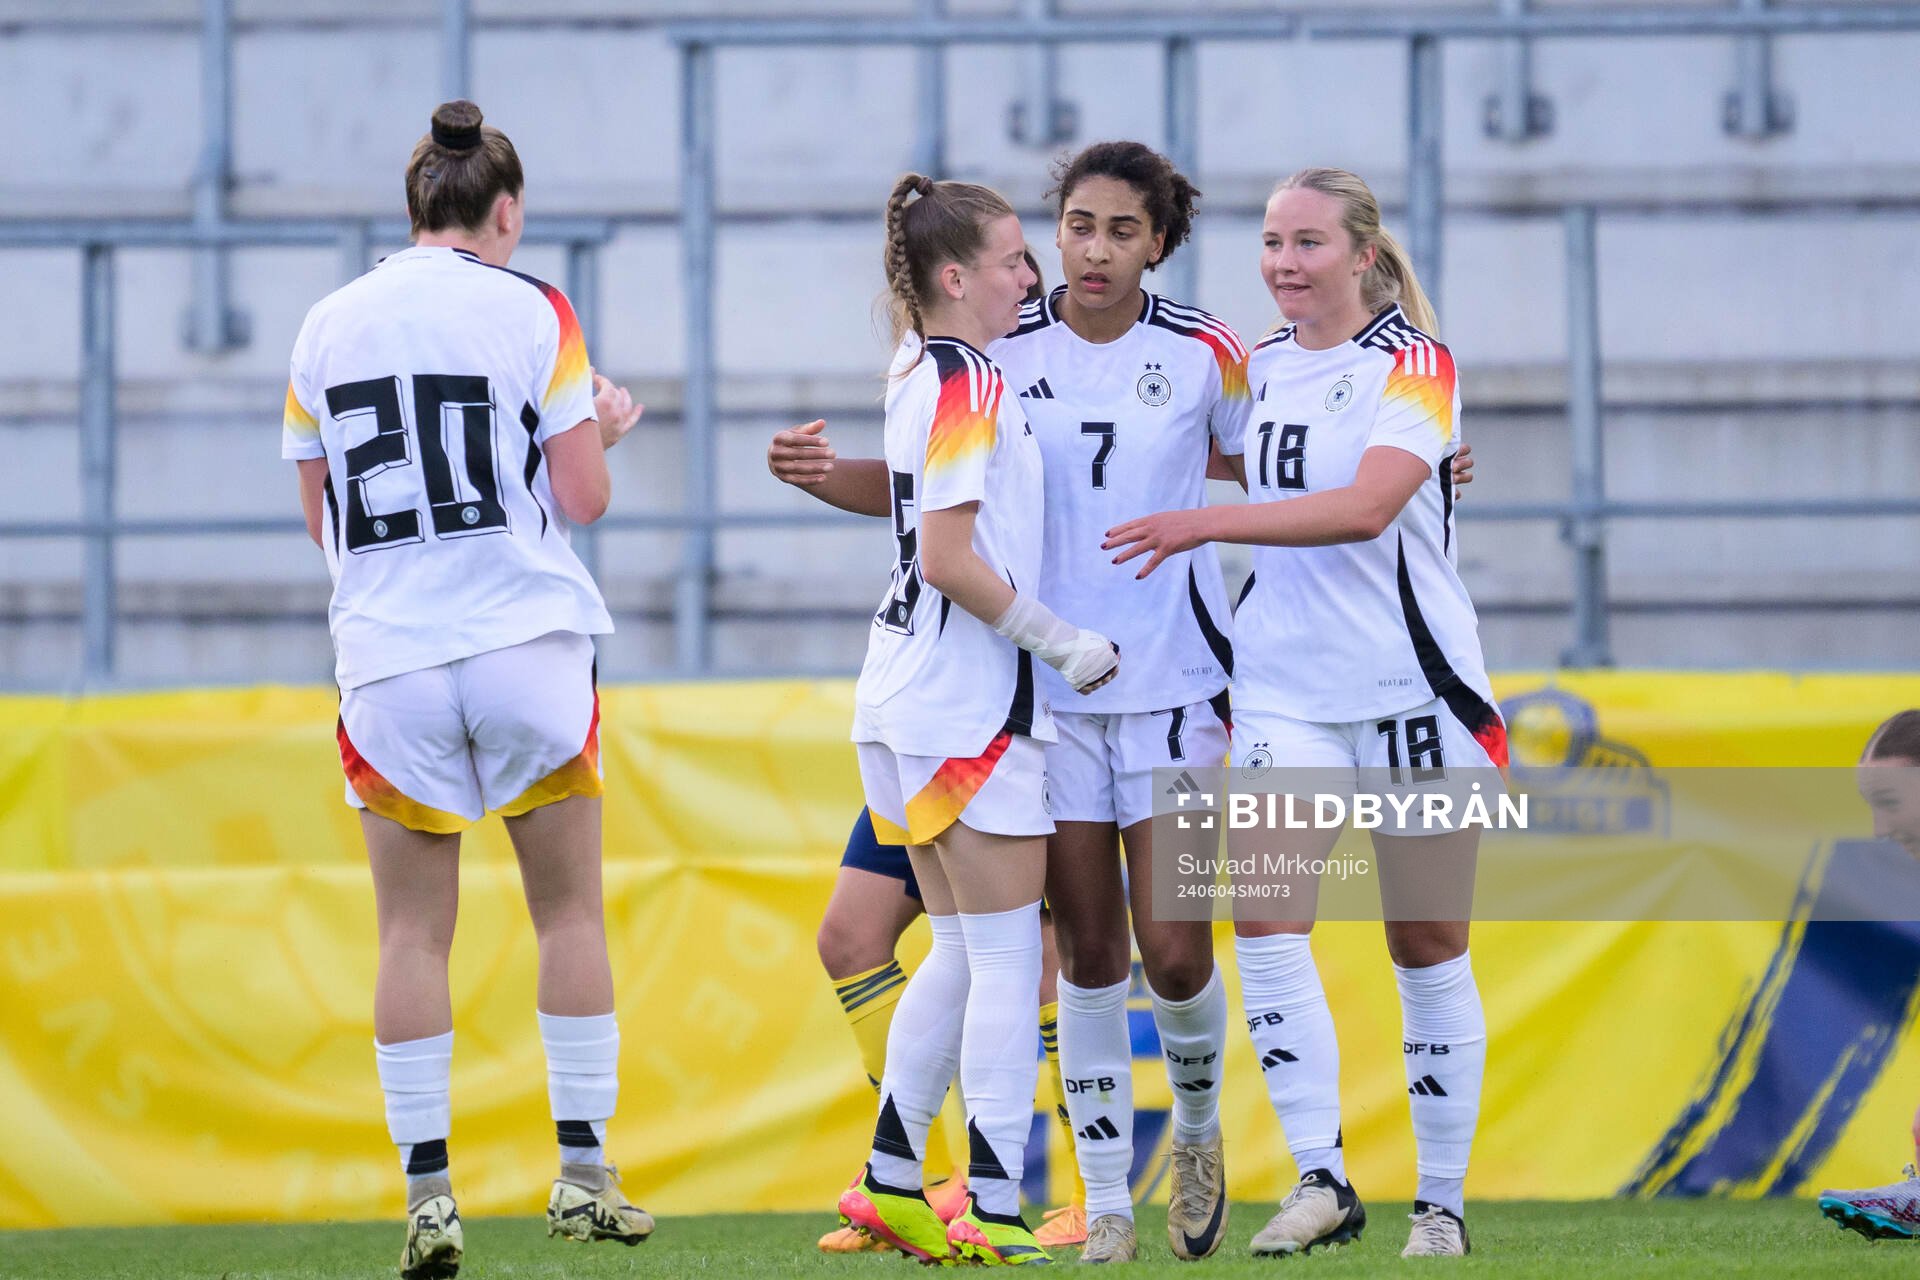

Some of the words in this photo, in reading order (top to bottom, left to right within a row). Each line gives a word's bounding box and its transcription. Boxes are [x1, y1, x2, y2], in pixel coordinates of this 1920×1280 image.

[325, 374, 512, 554] 20
[1080, 421, 1118, 490] 7
[1257, 421, 1310, 492] 18
[1151, 706, 1187, 762] 7
[1377, 714, 1448, 786] 18
[1166, 1049, 1217, 1066] DFB
[1403, 1041, 1450, 1055] DFB
[1065, 1076, 1116, 1094] DFB
